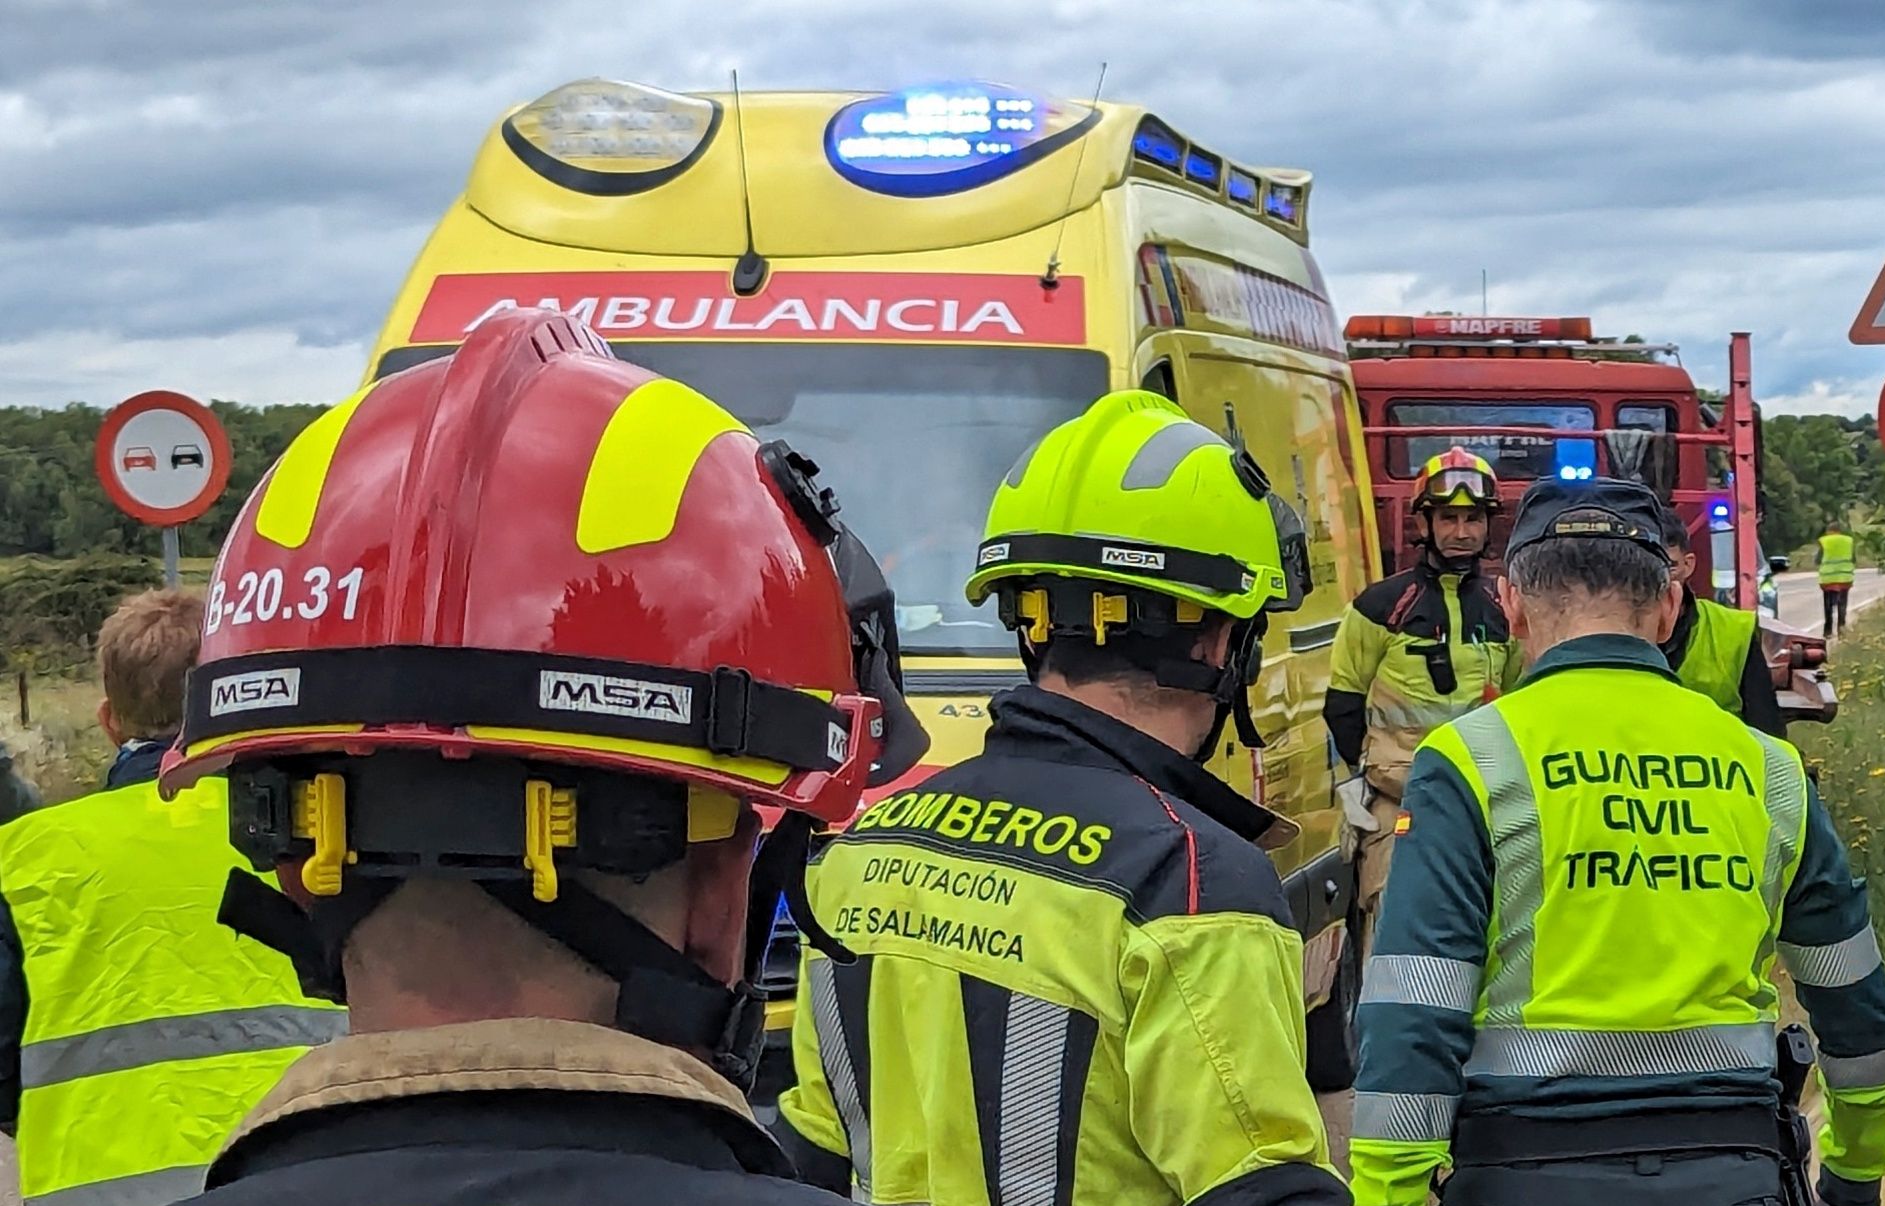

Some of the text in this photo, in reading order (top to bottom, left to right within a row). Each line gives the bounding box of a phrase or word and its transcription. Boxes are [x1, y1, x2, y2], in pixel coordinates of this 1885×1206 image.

[1450, 319, 1542, 335] MAPFRE
[1105, 550, 1161, 567] MSA
[205, 565, 364, 636] B-20.31
[214, 676, 290, 707] MSA
[551, 680, 682, 716] MSA
[1541, 750, 1756, 798] GUARDIA
[854, 793, 1113, 866] BOMBEROS
[1602, 794, 1710, 836] CIVIL
[863, 857, 1019, 907] DIPUTACIÓN
[834, 907, 1025, 963] DE SALAMANCA
